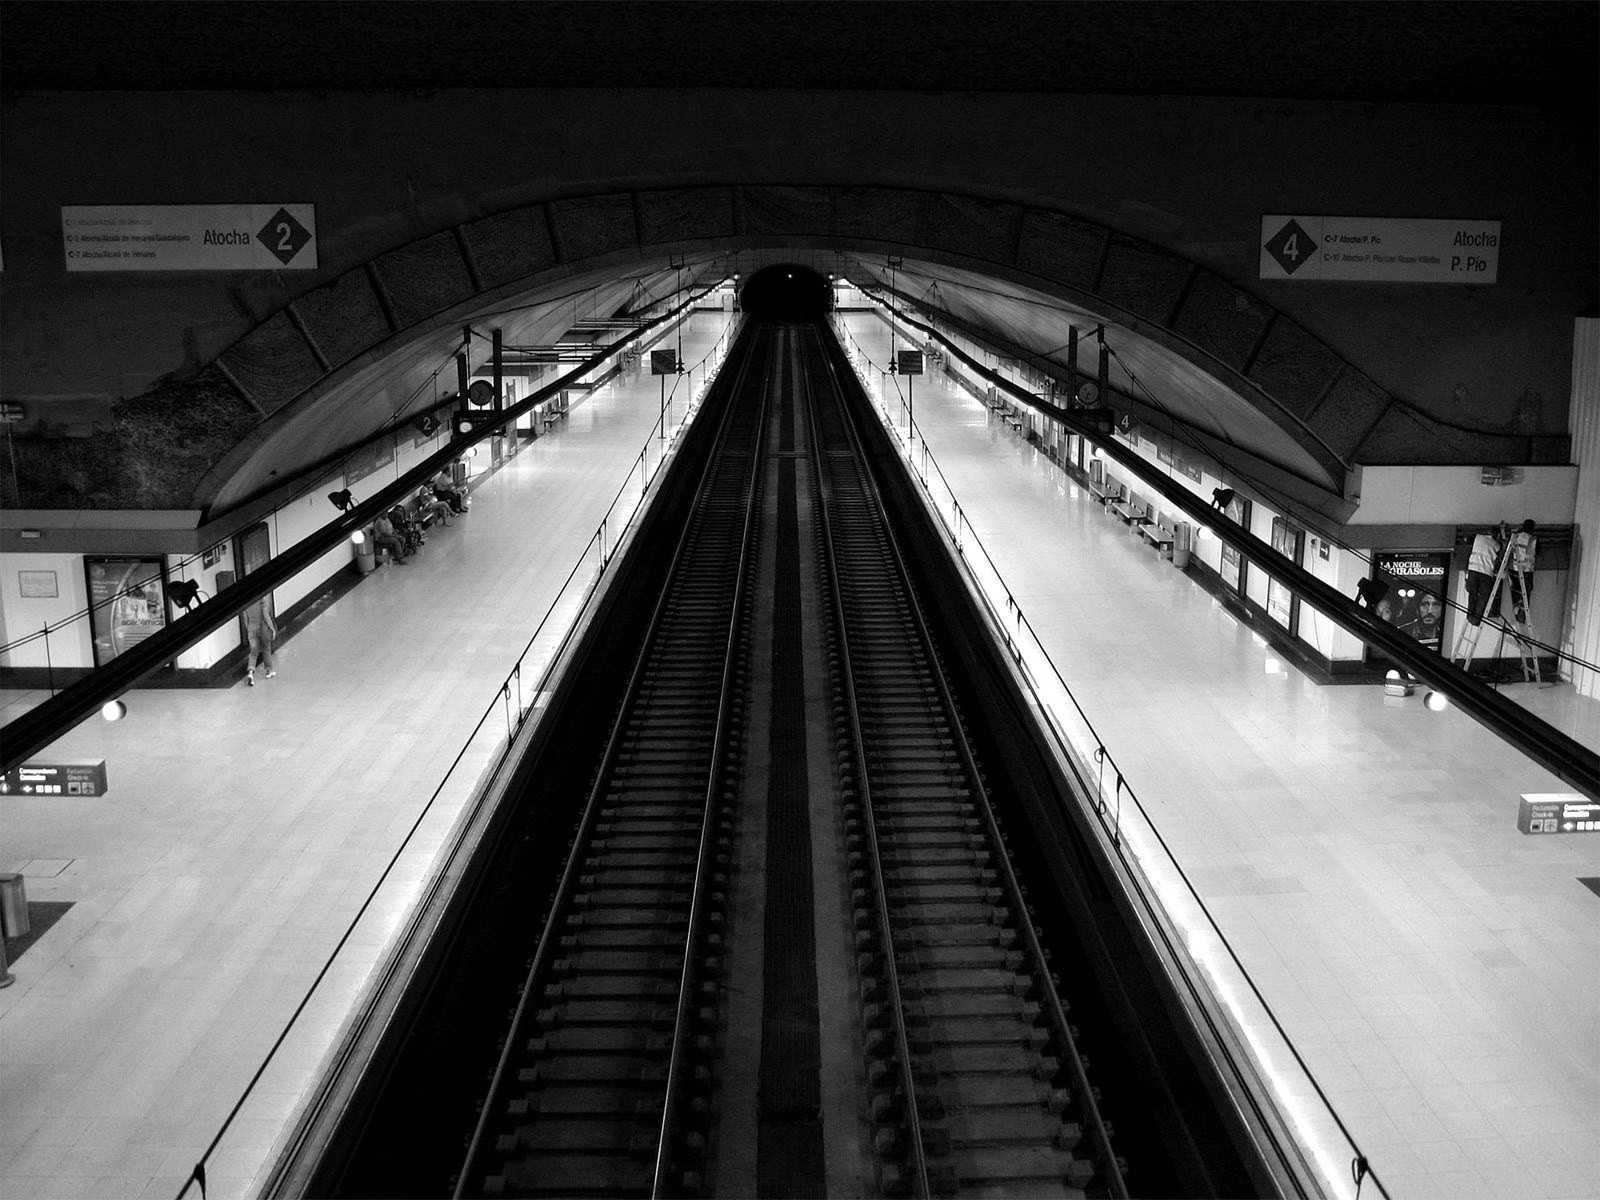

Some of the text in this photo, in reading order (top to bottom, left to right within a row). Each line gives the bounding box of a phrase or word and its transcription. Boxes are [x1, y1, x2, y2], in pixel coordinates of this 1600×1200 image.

[203, 229, 250, 245] Atocha
[276, 222, 293, 250] 2
[1452, 231, 1497, 247] Atocha
[1281, 233, 1299, 261] 4
[1450, 255, 1487, 272] P. Pío
[423, 417, 431, 430] 2
[1121, 415, 1129, 428] 4
